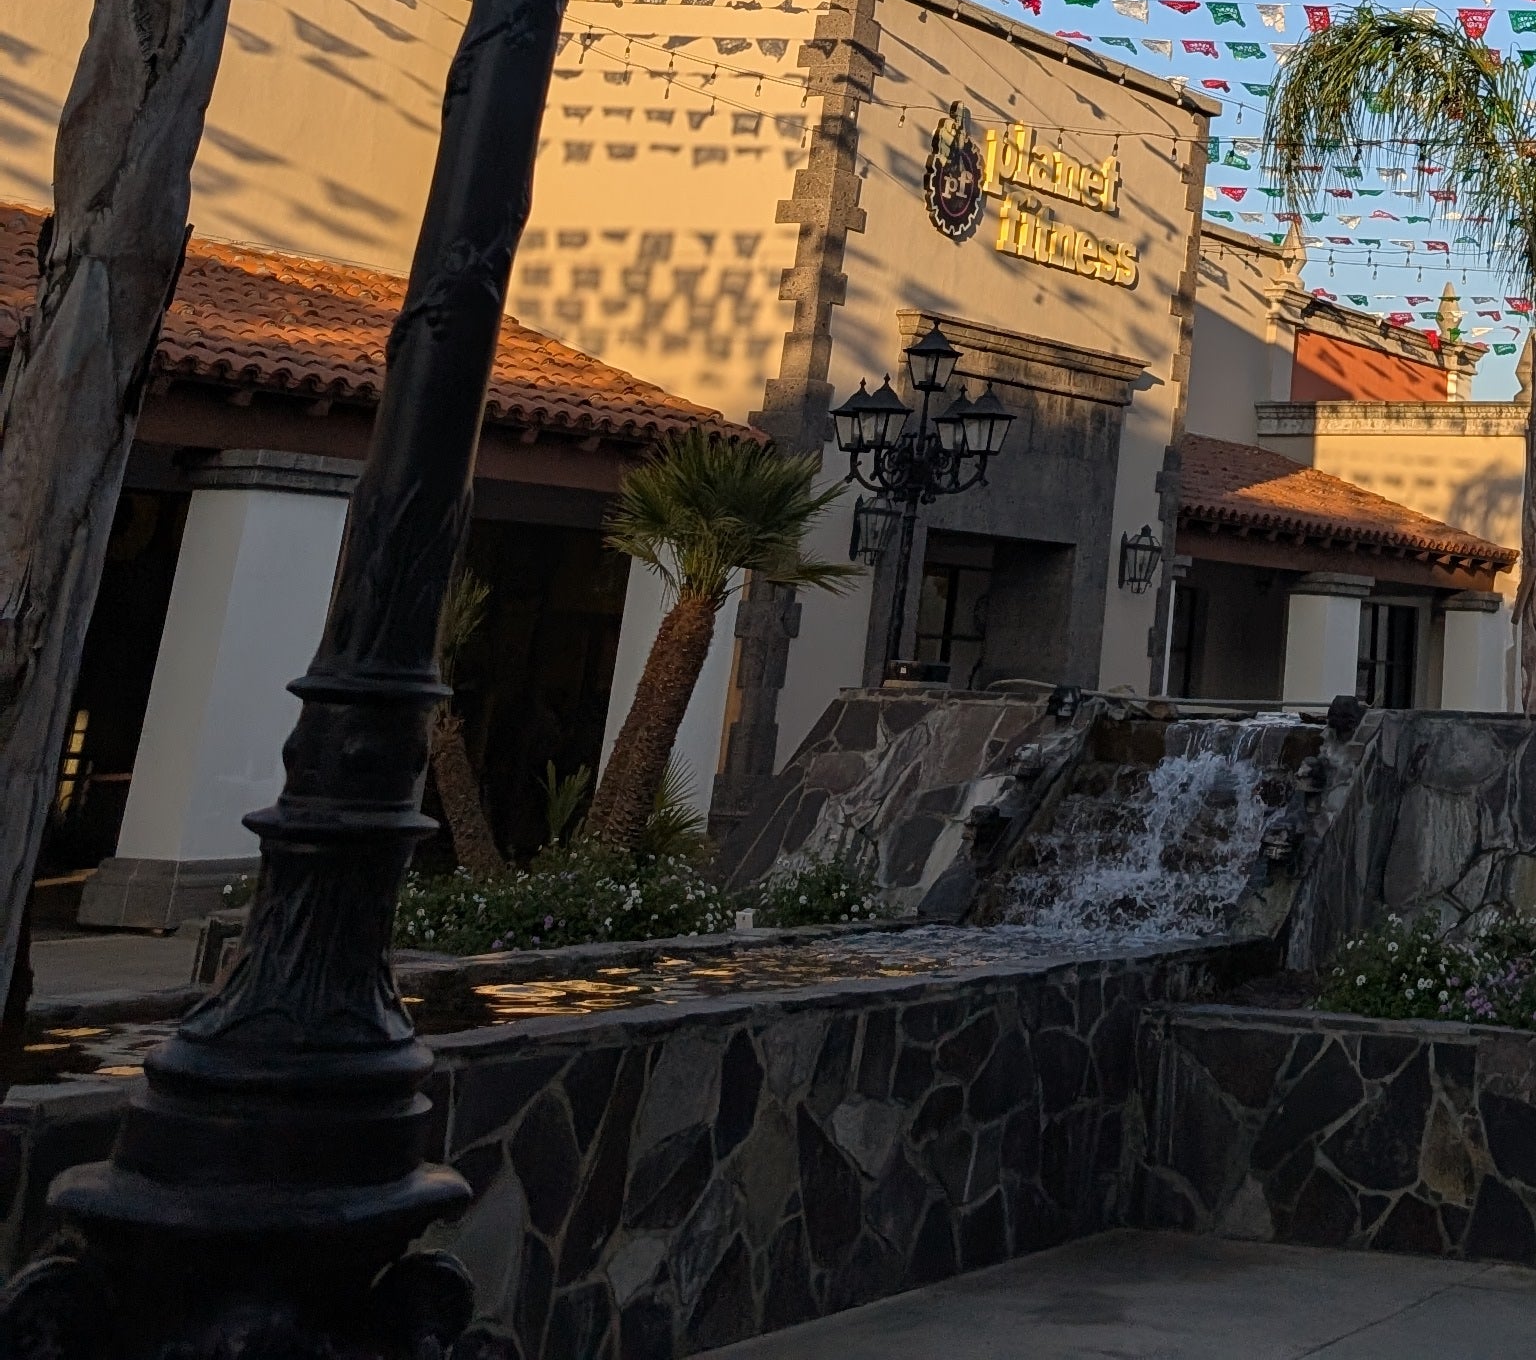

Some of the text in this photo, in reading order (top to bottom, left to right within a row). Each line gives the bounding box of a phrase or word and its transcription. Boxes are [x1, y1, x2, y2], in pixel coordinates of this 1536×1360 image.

[942, 170, 972, 200] pf
[983, 120, 1120, 213] planet
[996, 190, 1139, 288] fitness
